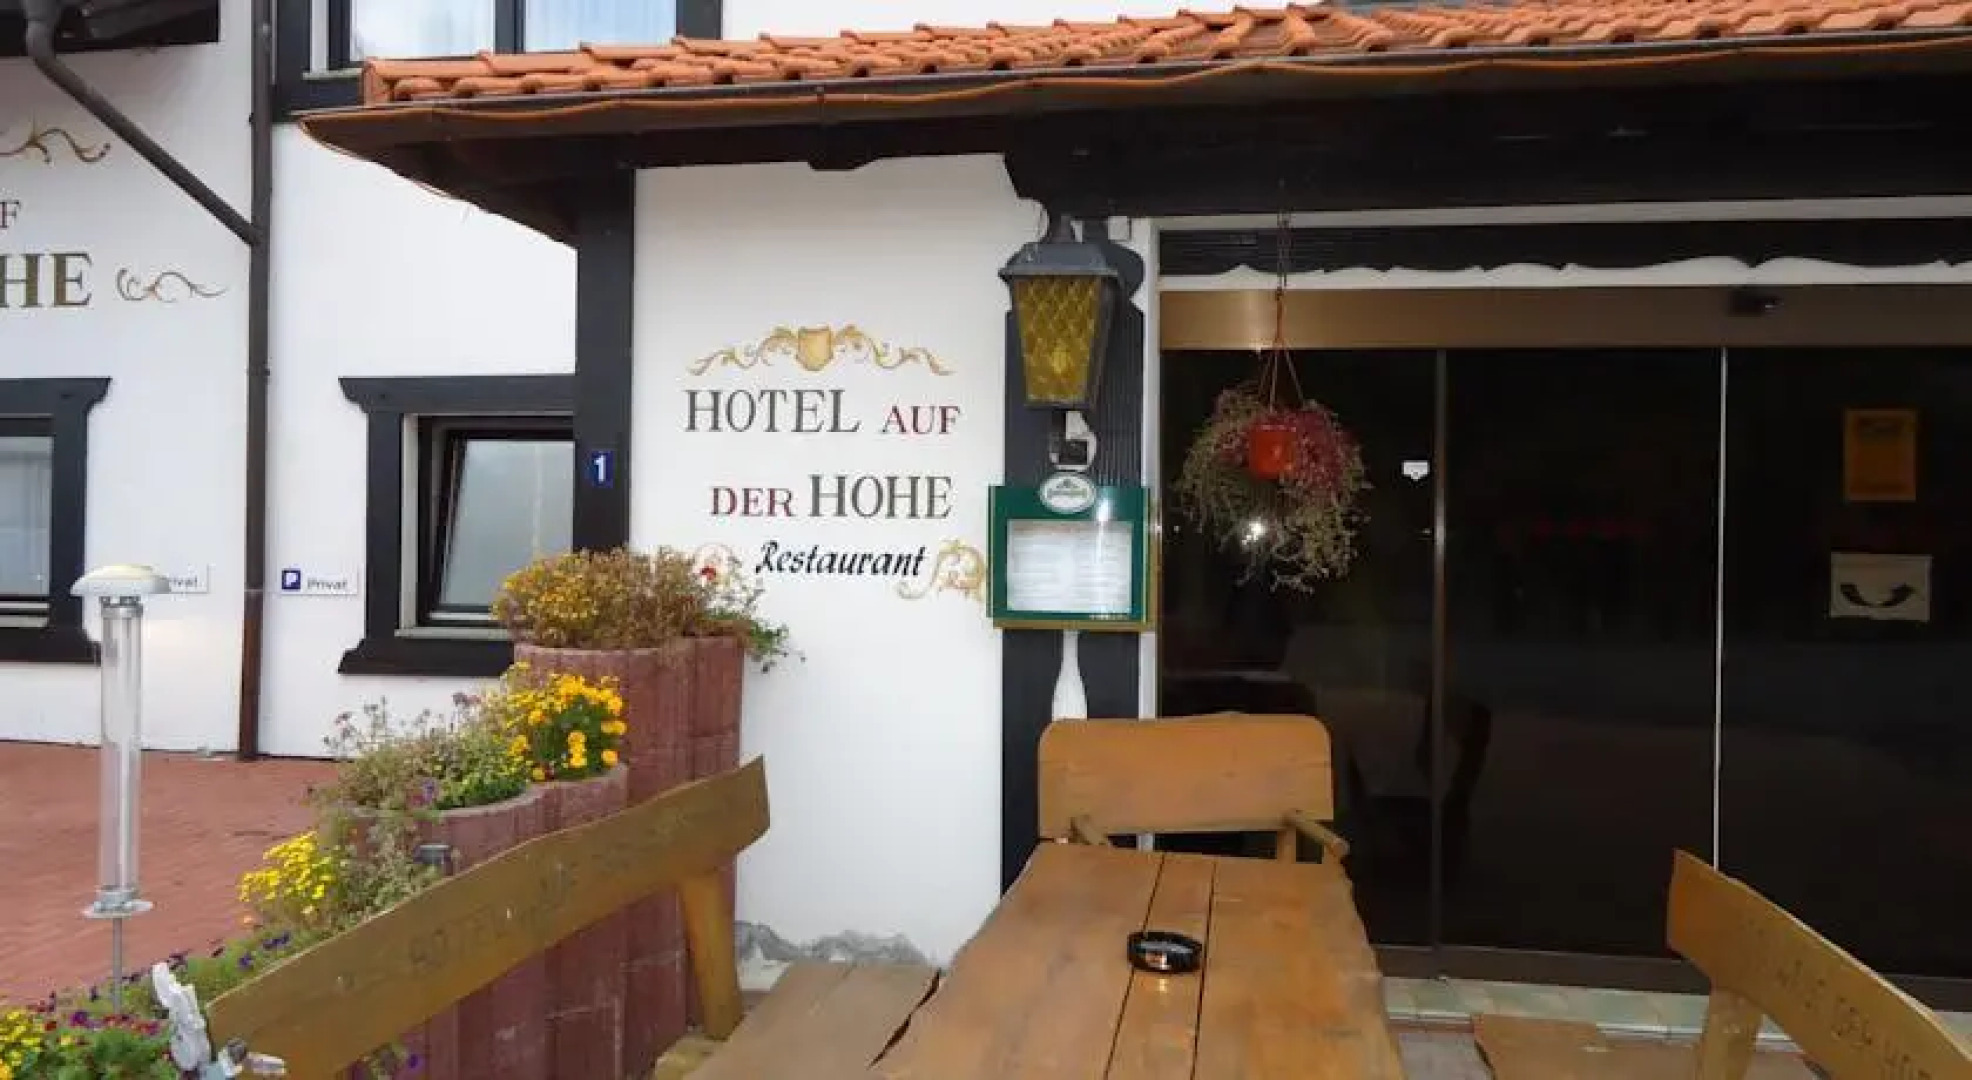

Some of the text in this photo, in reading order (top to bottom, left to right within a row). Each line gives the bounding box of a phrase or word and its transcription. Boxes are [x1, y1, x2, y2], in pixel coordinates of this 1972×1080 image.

[684, 388, 961, 435] HOTEL AUF
[593, 454, 607, 483] 1
[709, 473, 955, 519] DER HOHE
[755, 539, 926, 576] Restaurant
[306, 577, 349, 591] Privat
